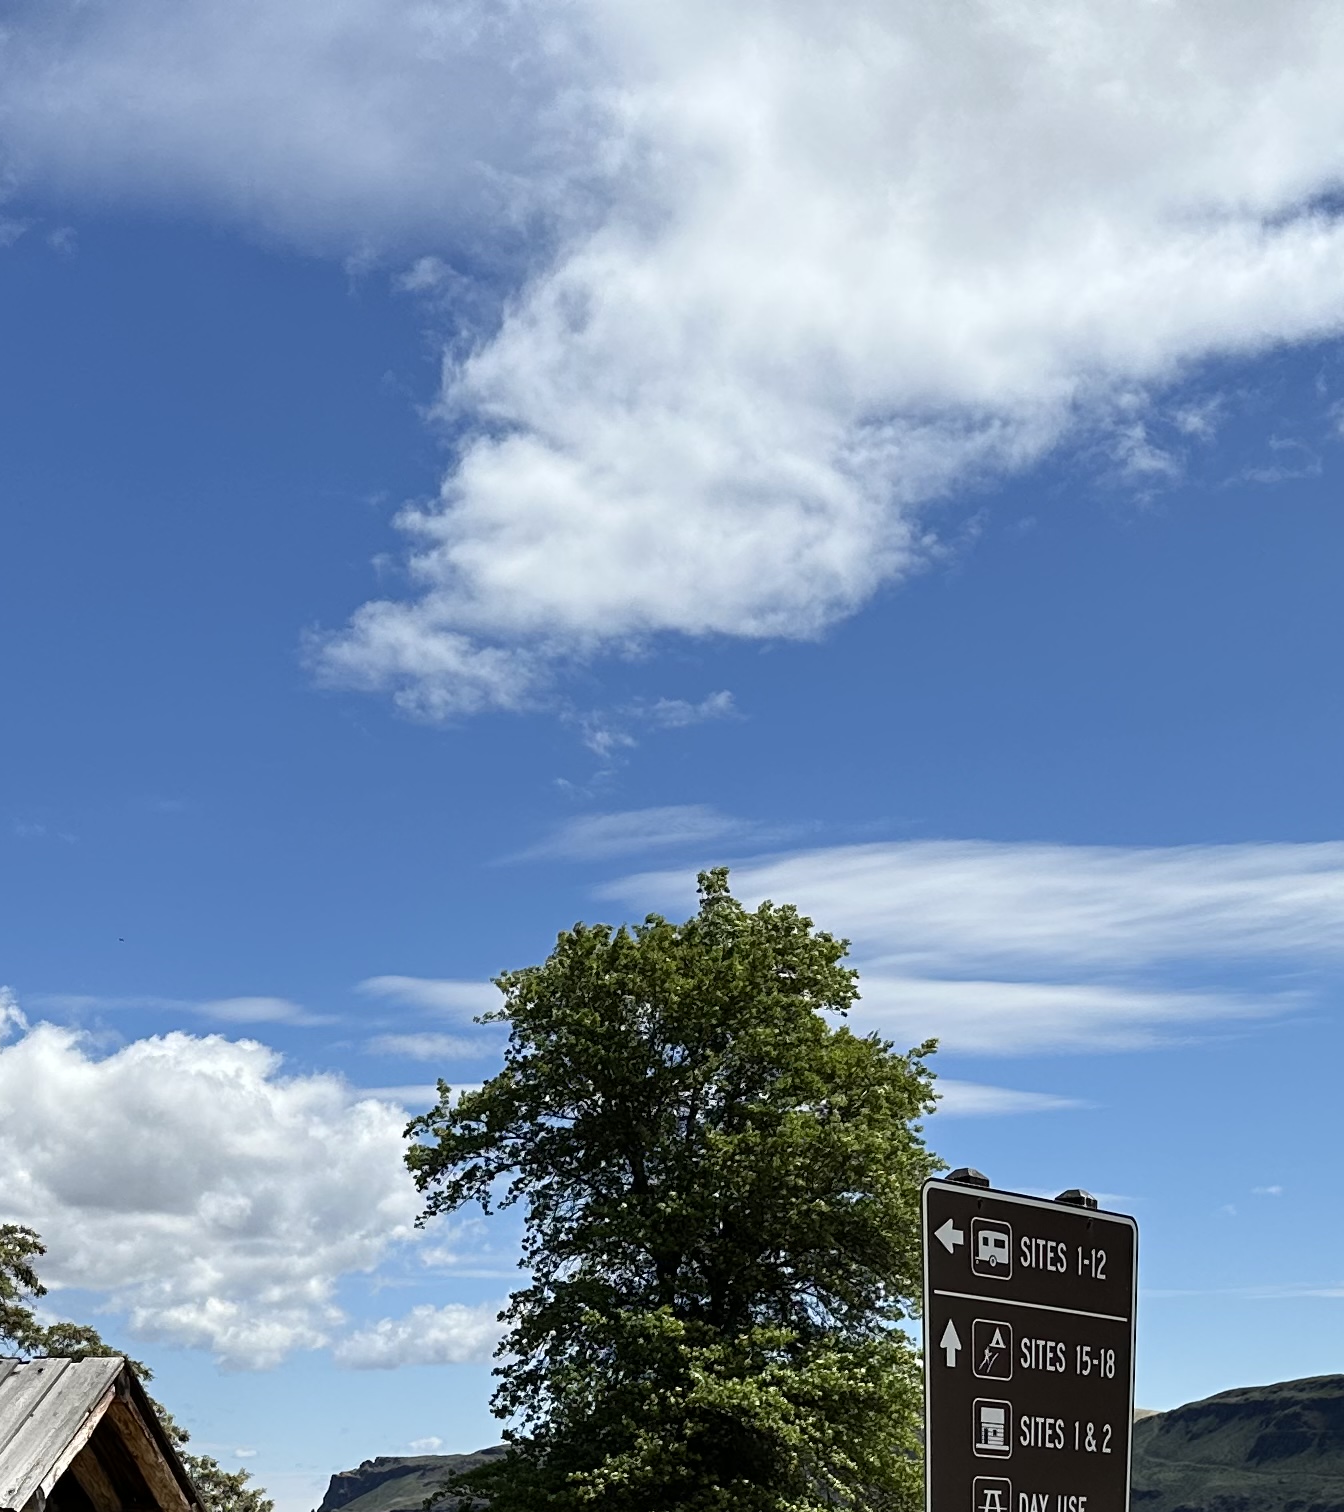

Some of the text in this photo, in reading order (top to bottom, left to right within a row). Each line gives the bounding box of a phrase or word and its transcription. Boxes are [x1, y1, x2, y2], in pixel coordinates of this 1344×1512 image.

[1020, 1236, 1107, 1280] SITES 1-12
[1020, 1337, 1116, 1380] SITES 15-18
[1019, 1415, 1112, 1455] SITES 1 & 2
